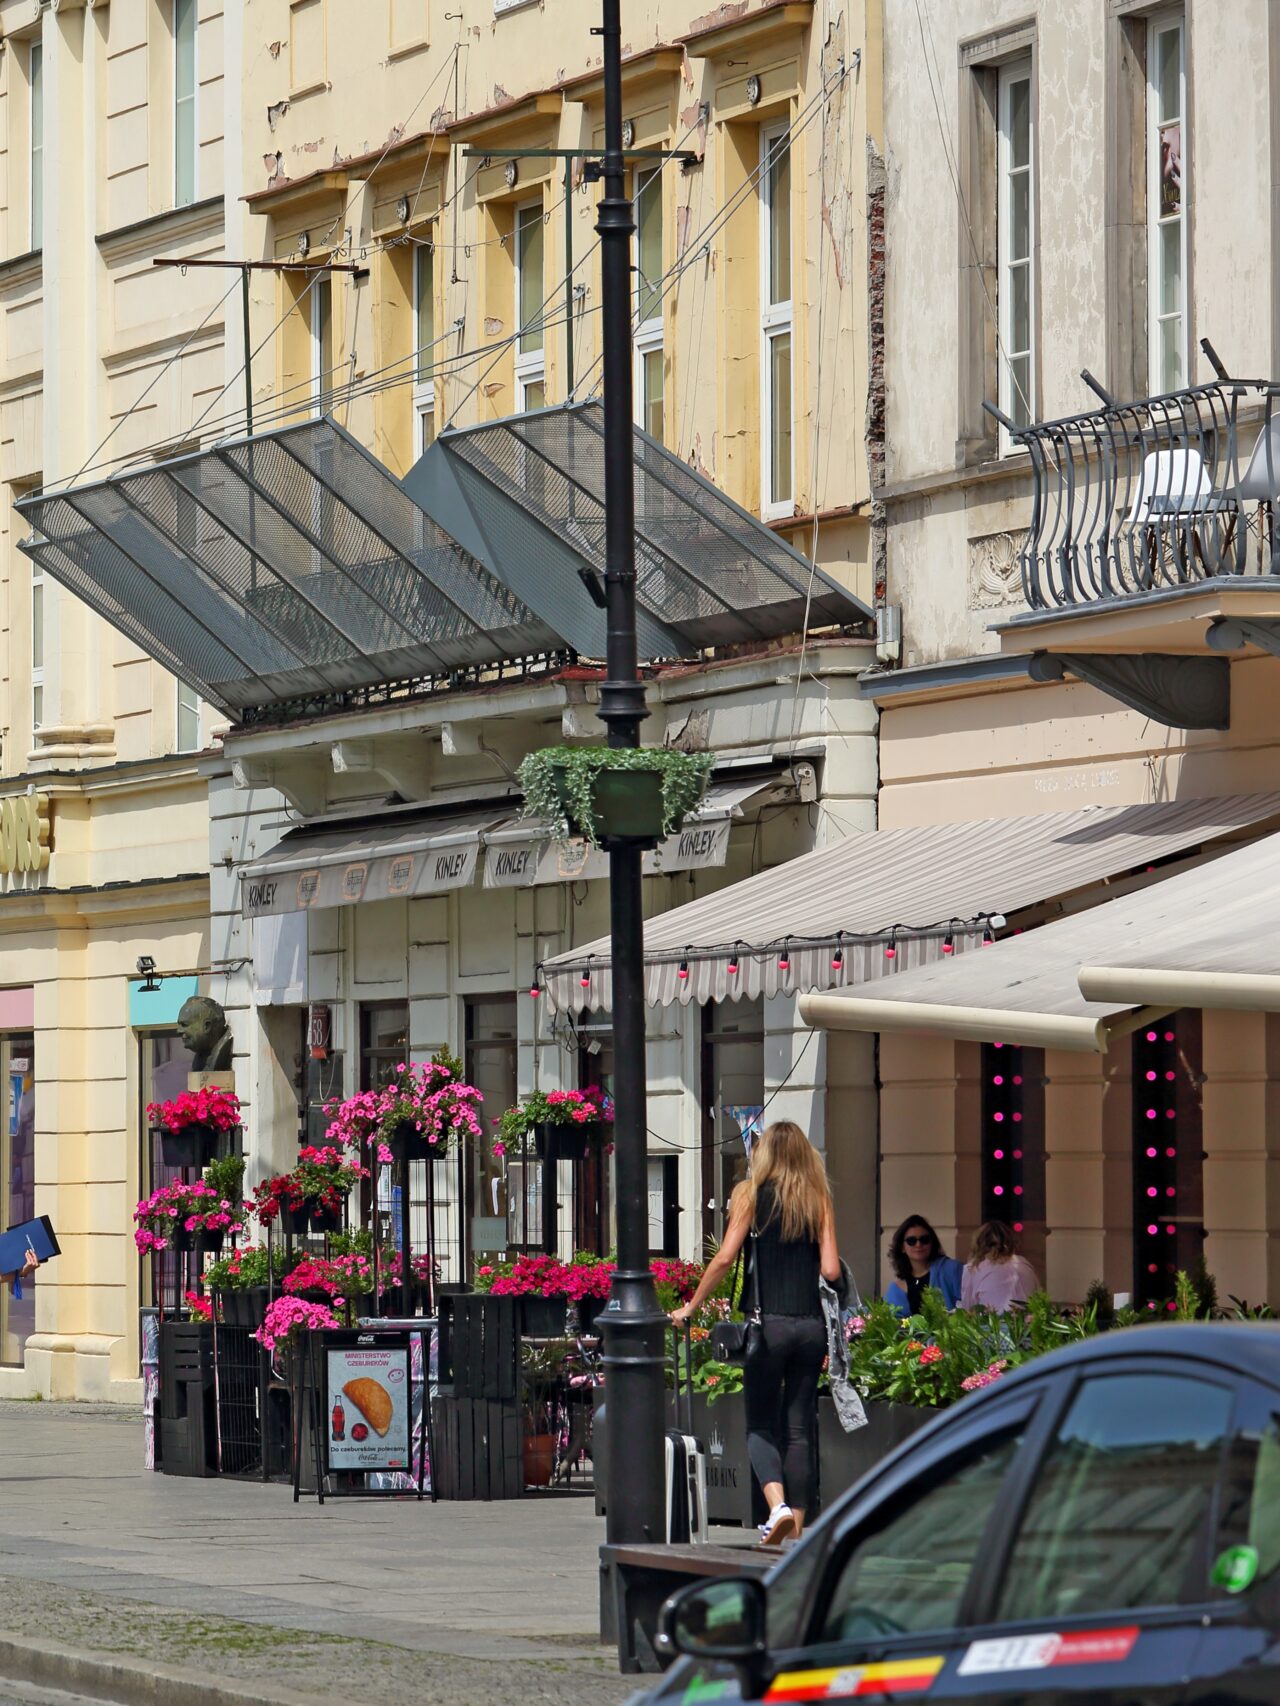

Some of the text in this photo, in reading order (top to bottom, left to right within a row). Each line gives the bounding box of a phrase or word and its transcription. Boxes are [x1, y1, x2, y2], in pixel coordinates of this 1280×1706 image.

[677, 829, 715, 857] KINLEY
[434, 853, 468, 881] KINLEY
[495, 850, 529, 877] KINLEY
[248, 882, 278, 908] KINLEY
